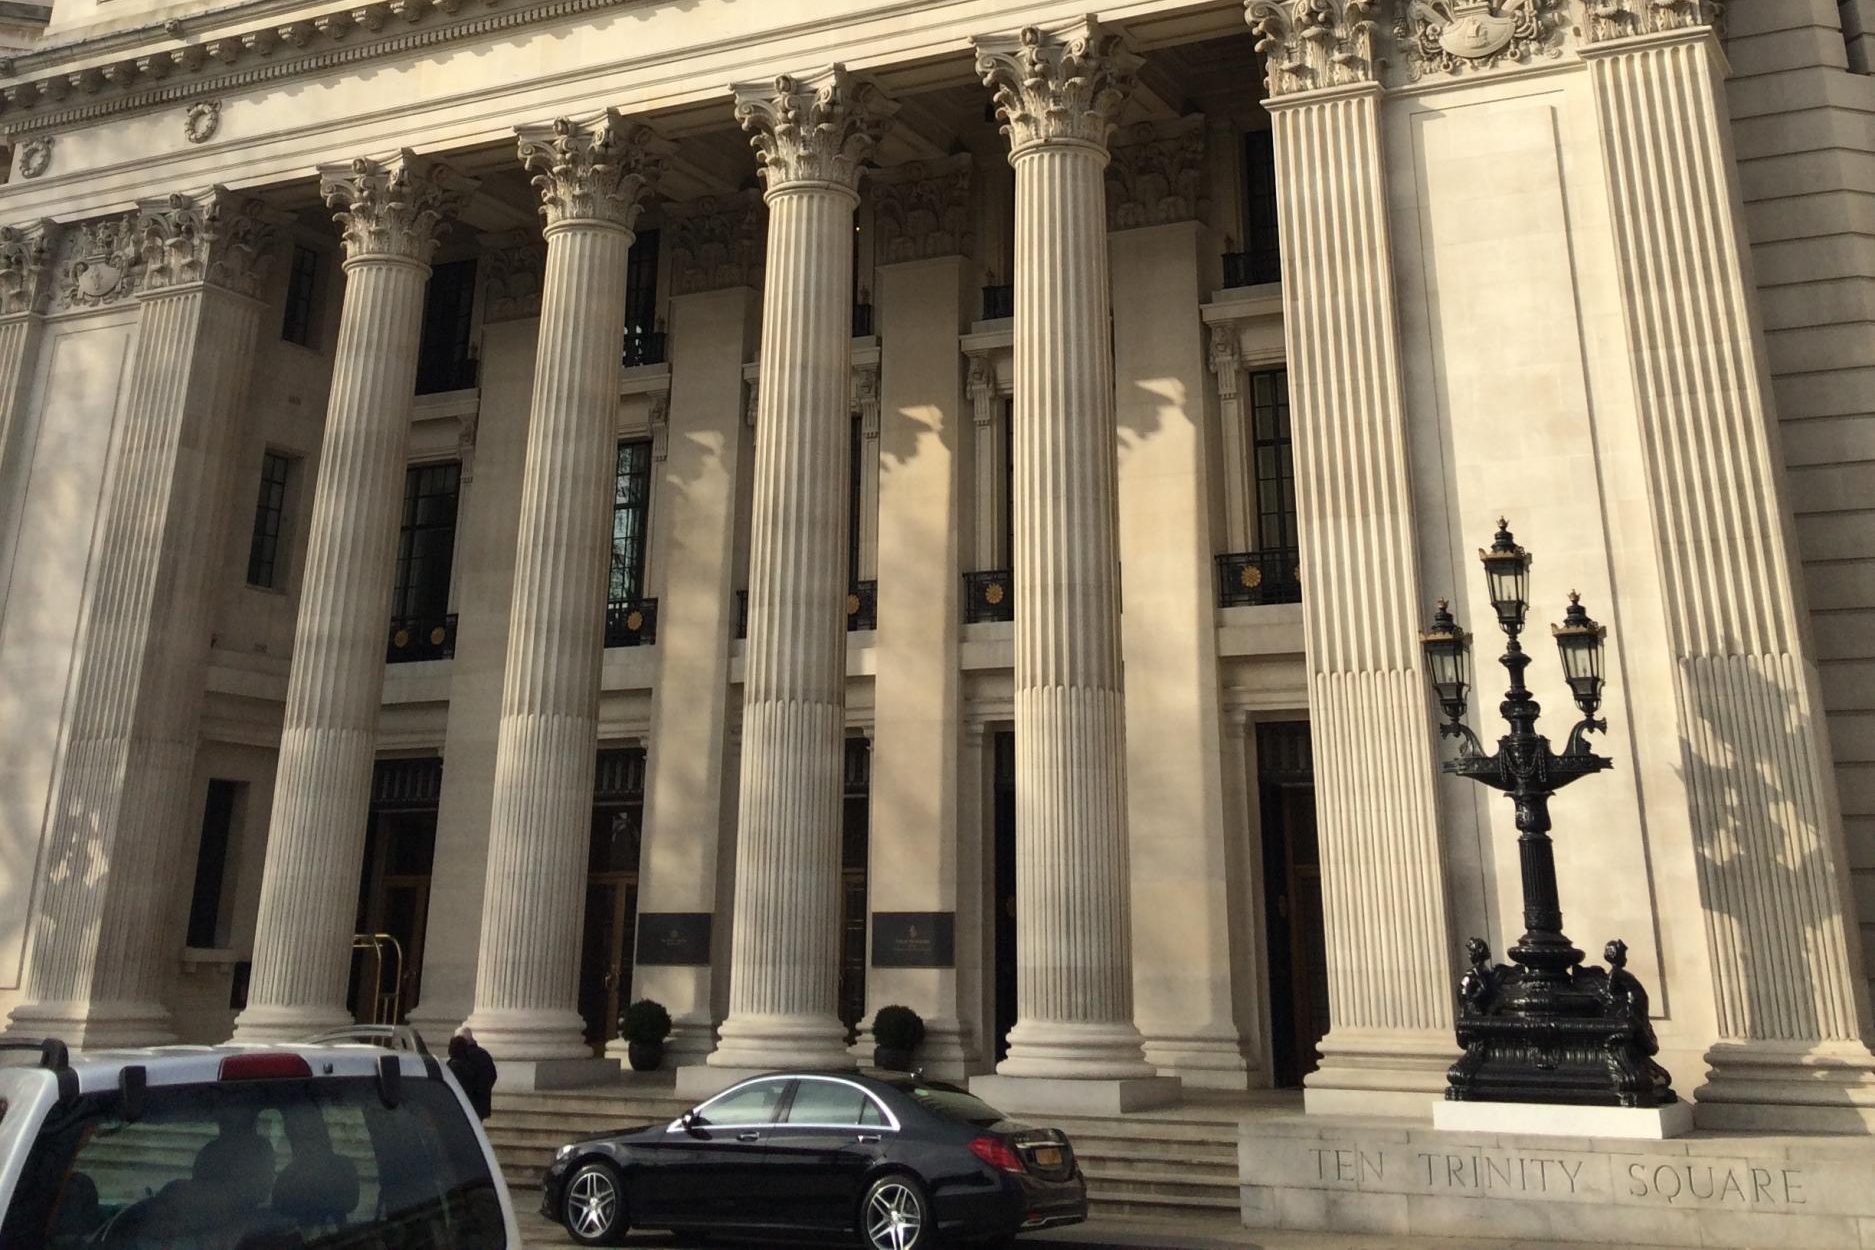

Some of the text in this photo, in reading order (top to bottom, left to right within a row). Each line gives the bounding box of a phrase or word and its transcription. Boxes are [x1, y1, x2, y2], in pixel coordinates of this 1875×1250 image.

[1309, 1149, 1807, 1204] TEN TRINITY SQUARE
